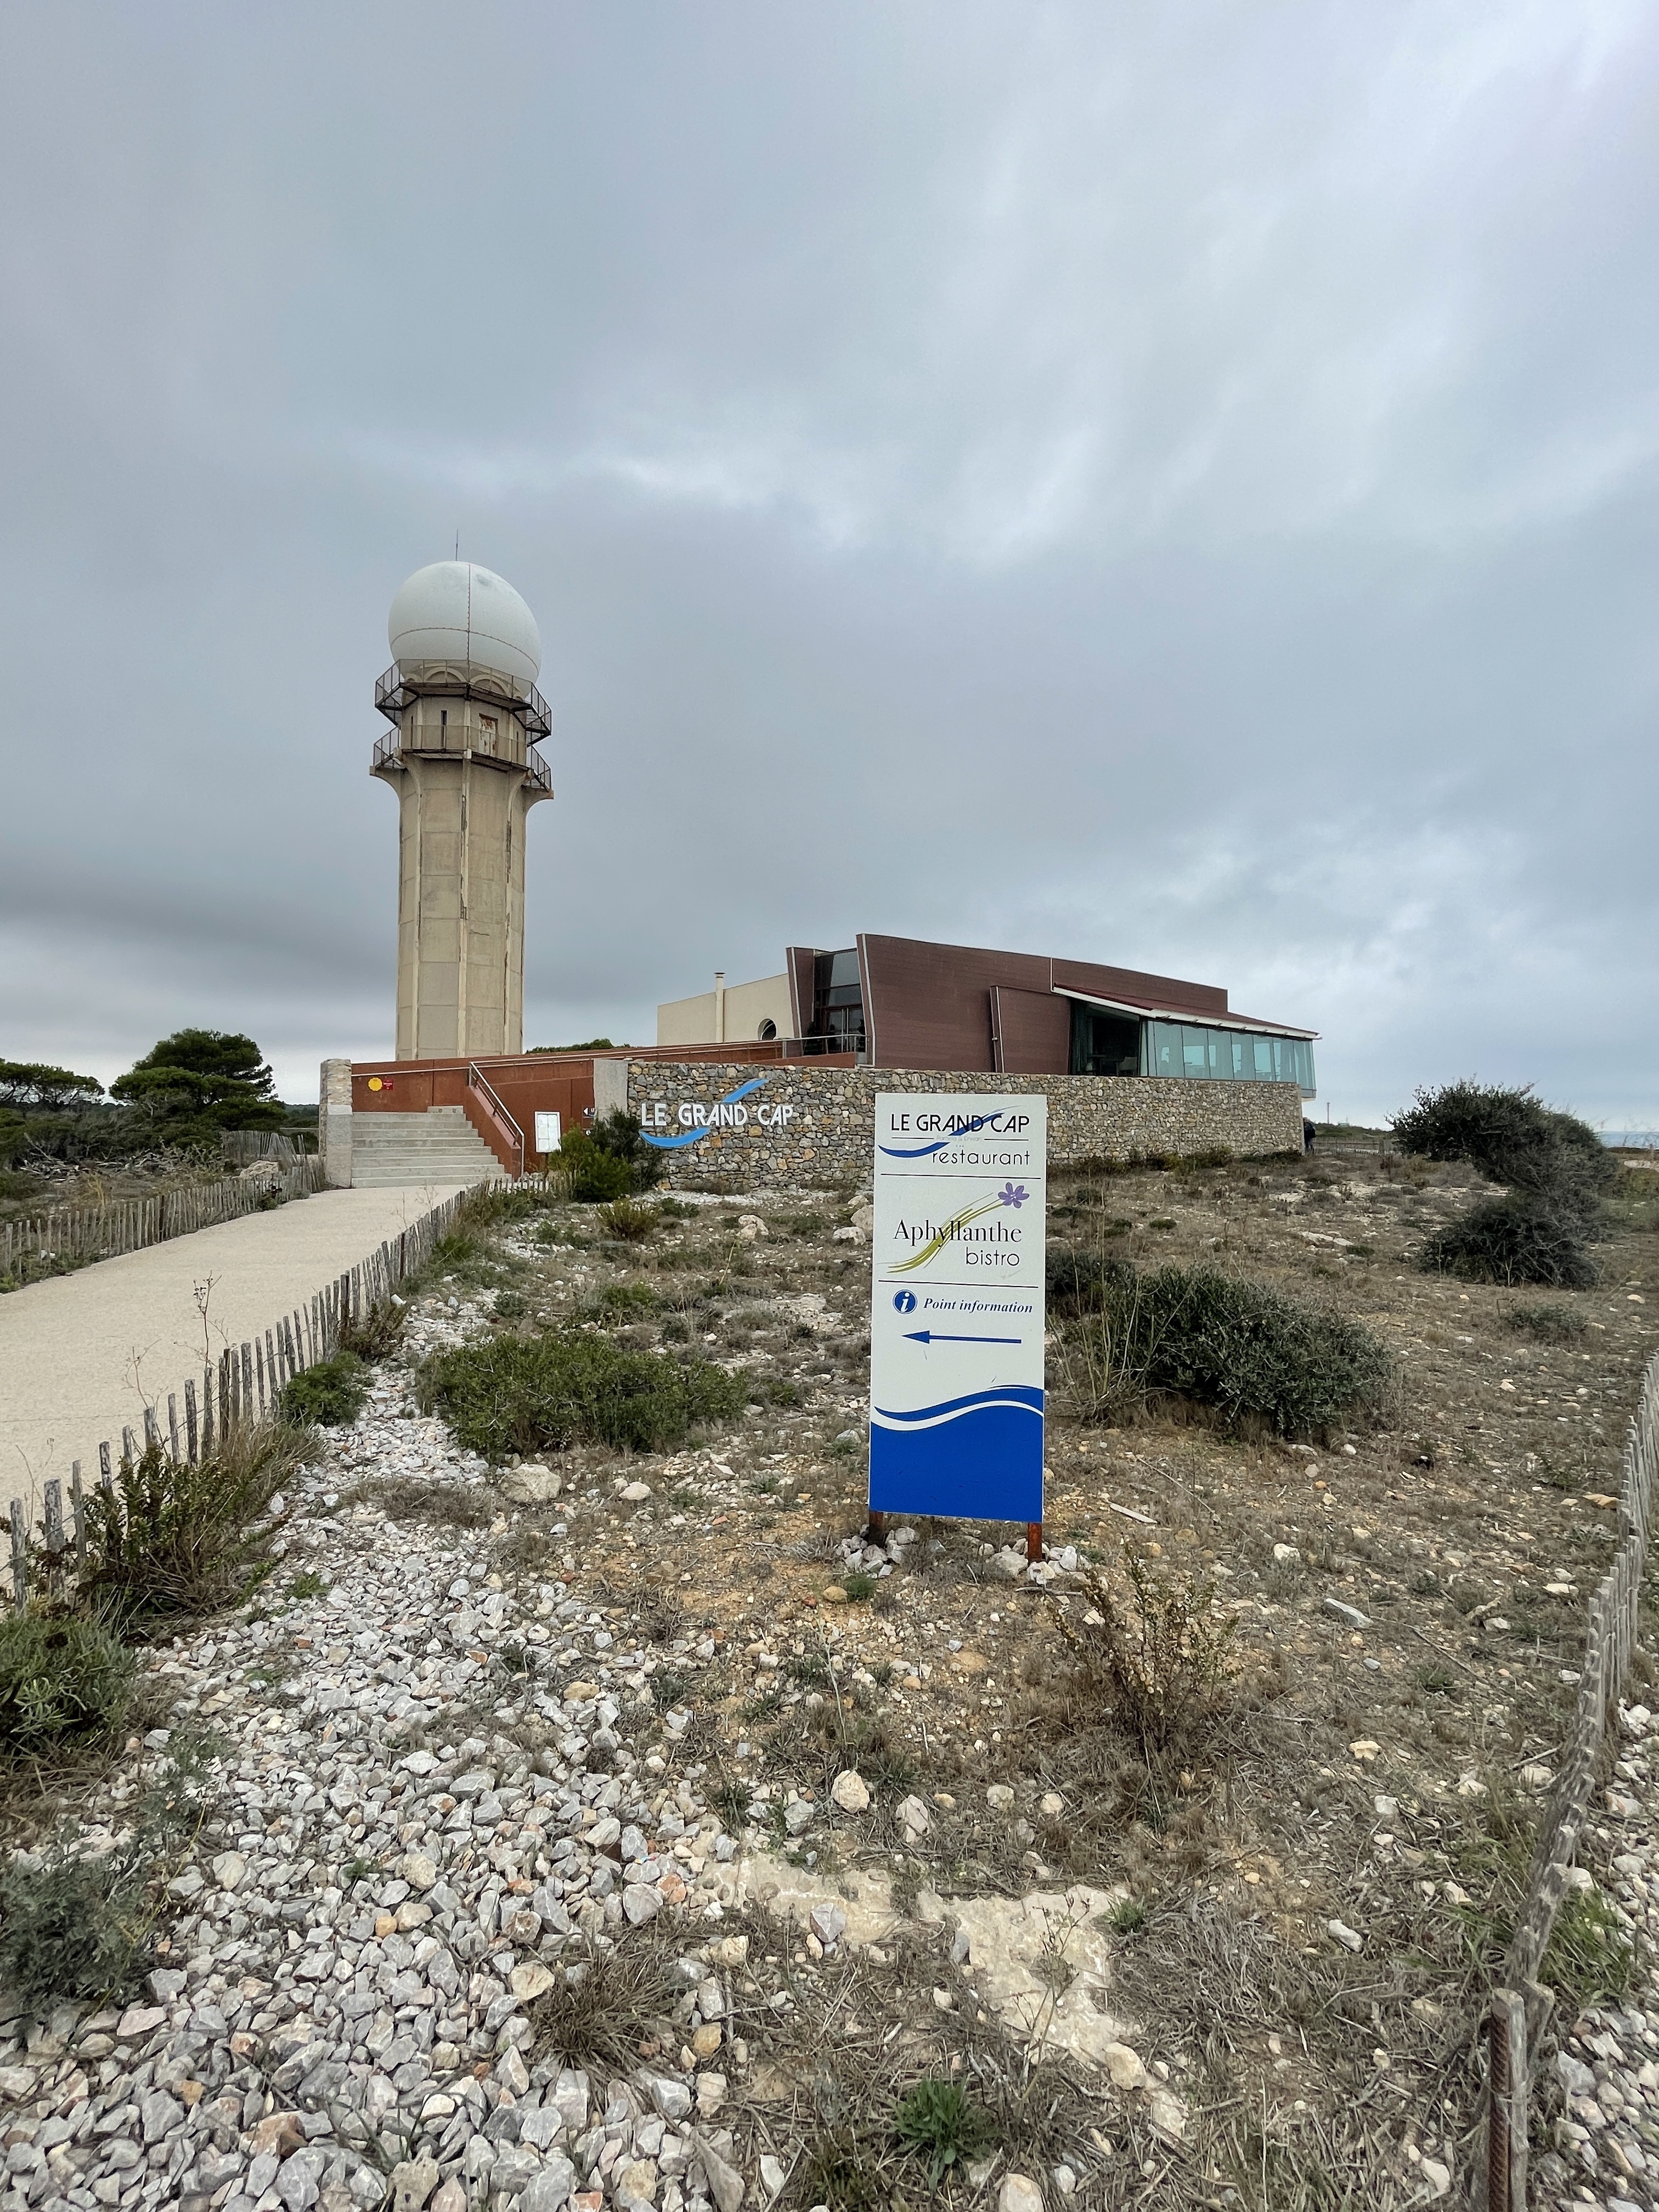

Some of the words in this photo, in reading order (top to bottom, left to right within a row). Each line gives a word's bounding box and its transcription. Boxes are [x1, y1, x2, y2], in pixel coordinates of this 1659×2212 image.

[641, 1103, 667, 1126] LE
[678, 1103, 747, 1126] GRAND
[757, 1104, 793, 1126] CAP
[891, 1114, 910, 1131] LE
[916, 1114, 984, 1132] GRAND
[991, 1115, 1030, 1133] CAP
[932, 1149, 1030, 1165] restaurant
[893, 1219, 1022, 1247] Aphyllanthe
[966, 1246, 1020, 1266] bistro
[923, 1298, 956, 1310] Point
[960, 1300, 1033, 1313] information
